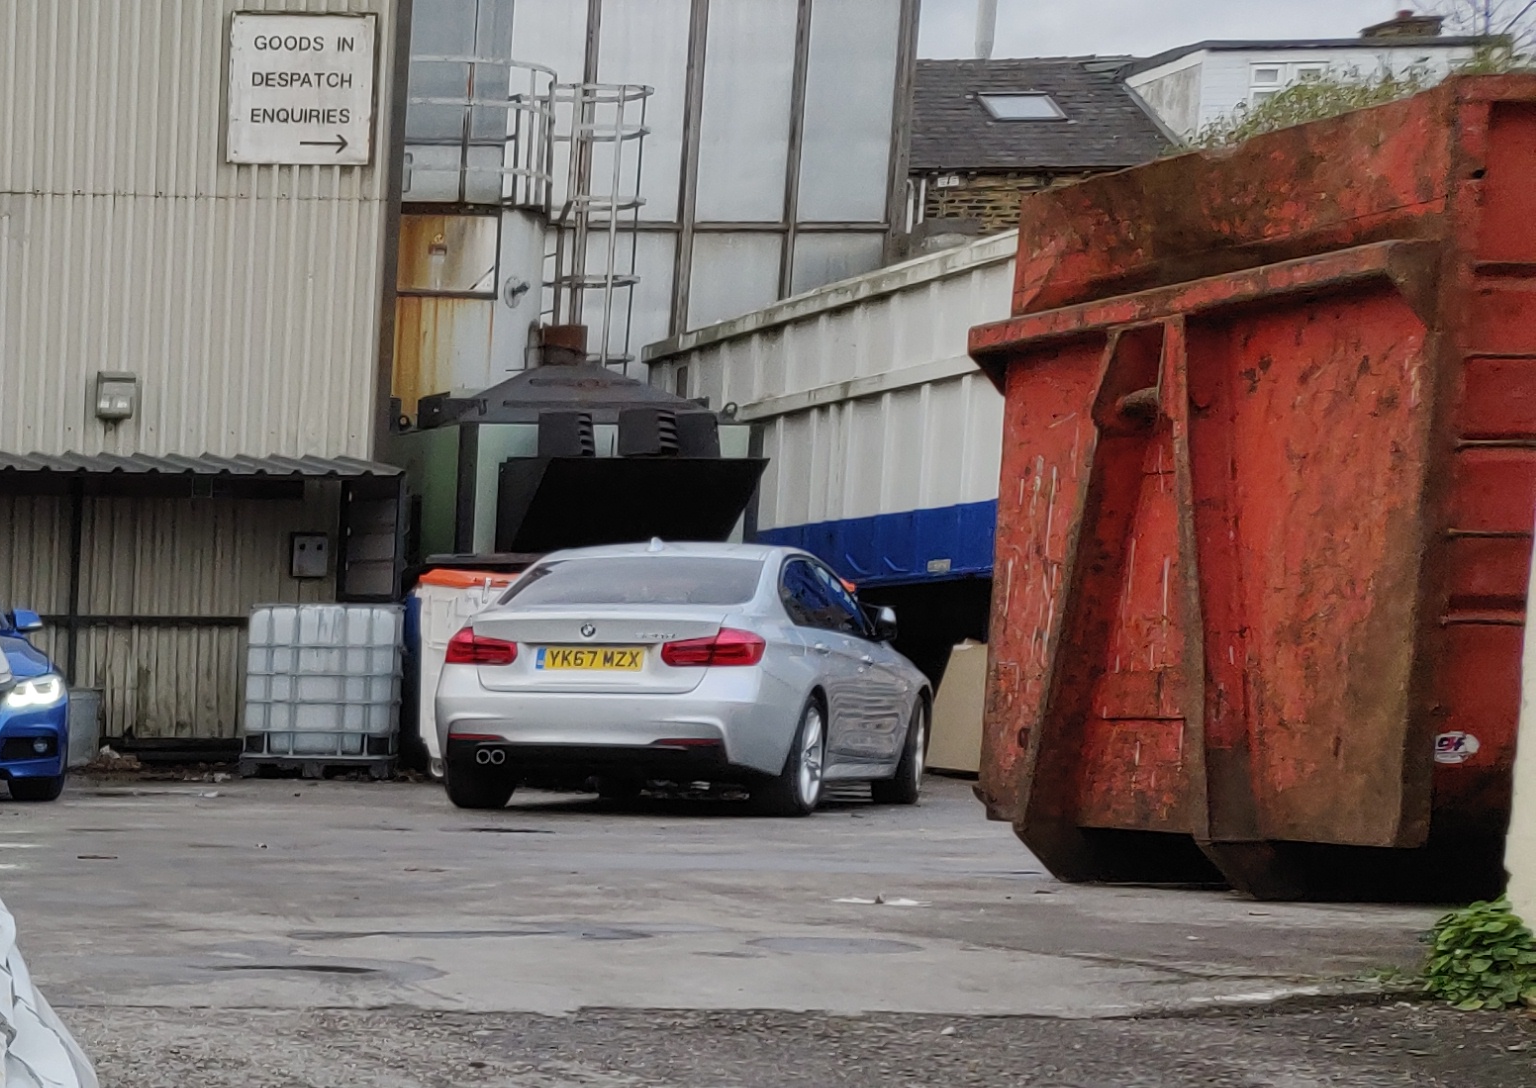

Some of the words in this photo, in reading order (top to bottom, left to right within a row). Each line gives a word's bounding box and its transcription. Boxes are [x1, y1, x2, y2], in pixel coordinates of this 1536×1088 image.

[254, 36, 324, 51] GOODS
[337, 37, 354, 52] IN
[252, 72, 352, 88] DESPATCH
[250, 108, 350, 124] ENQUIRIES
[549, 650, 598, 667] YK67
[602, 651, 640, 667] MZX
